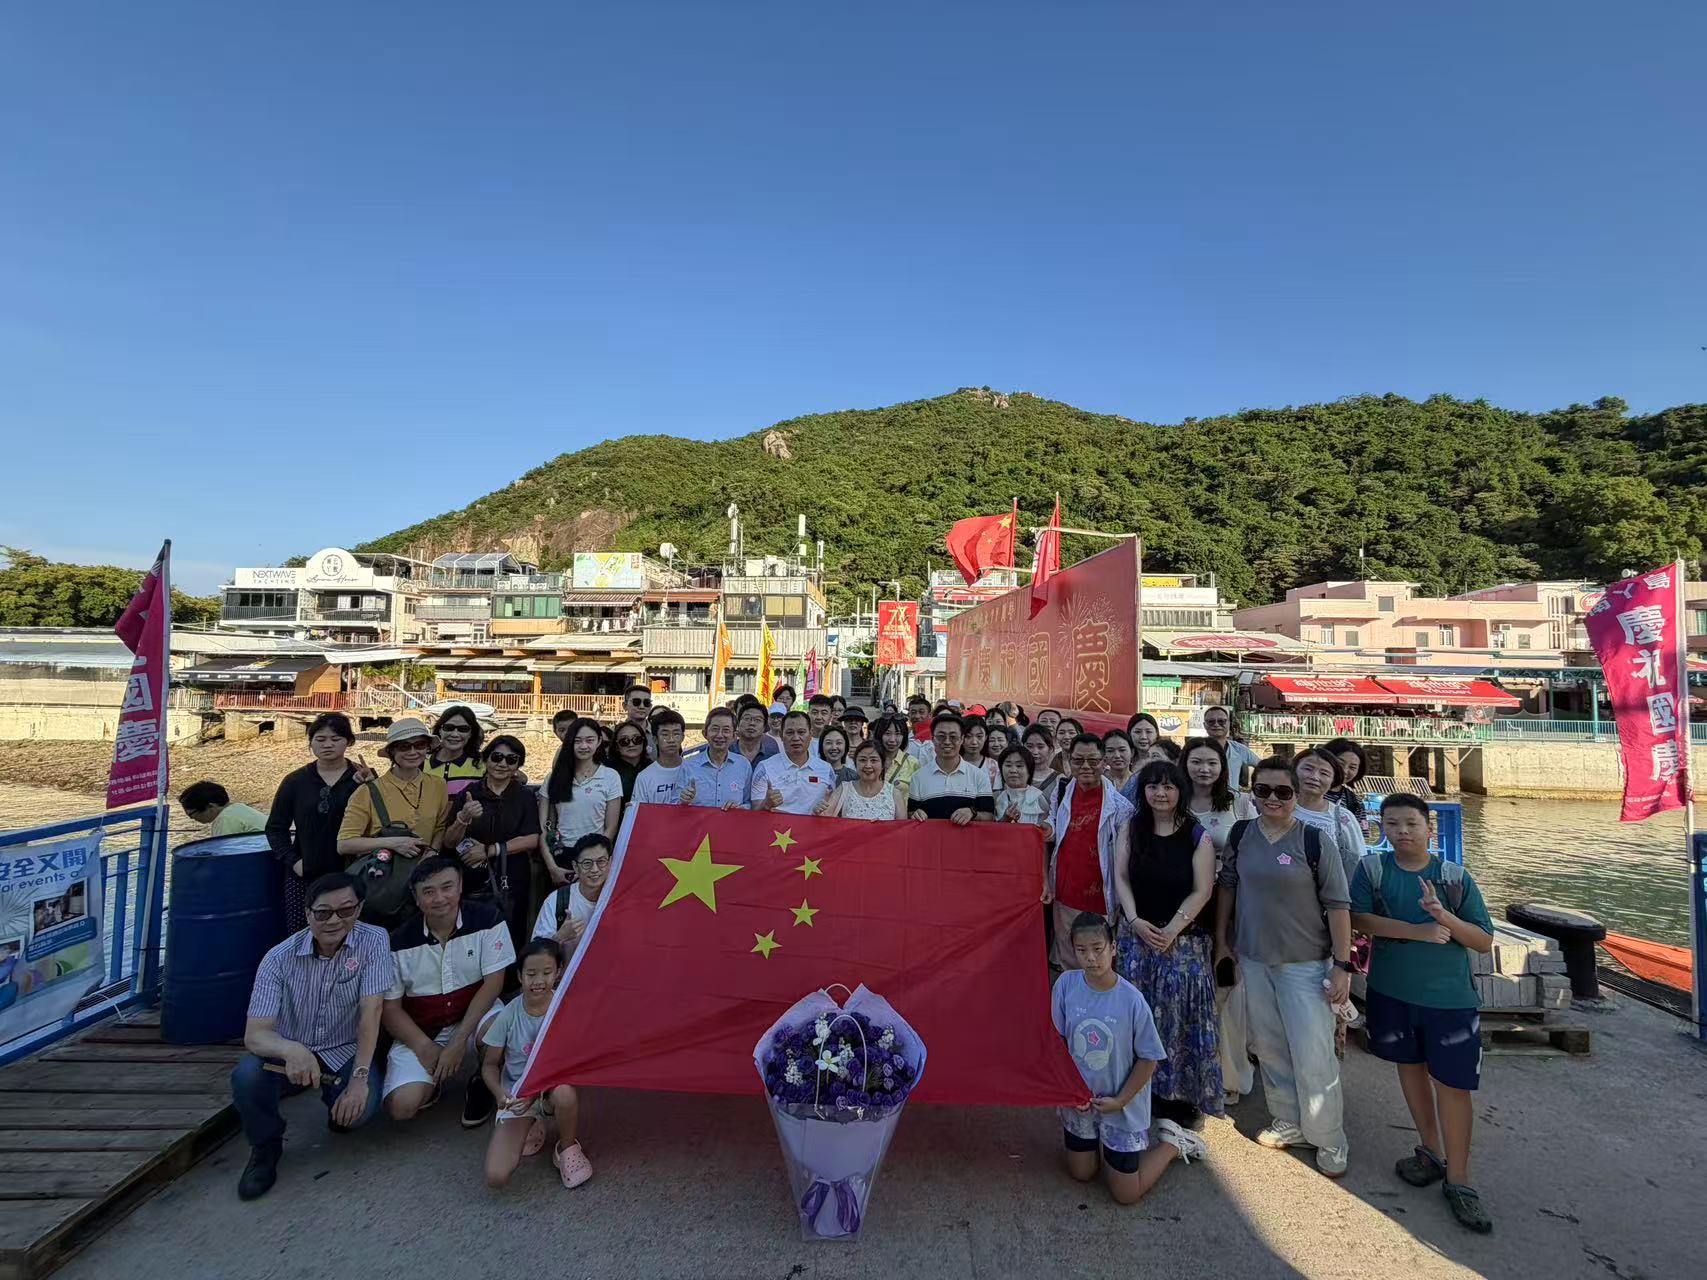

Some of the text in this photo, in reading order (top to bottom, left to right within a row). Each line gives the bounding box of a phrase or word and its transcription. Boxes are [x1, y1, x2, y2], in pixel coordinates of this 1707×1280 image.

[252, 570, 297, 579] NEXTWAVE
[113, 655, 160, 764] 國慶
[0, 883, 14, 893] or
[19, 872, 66, 889] events
